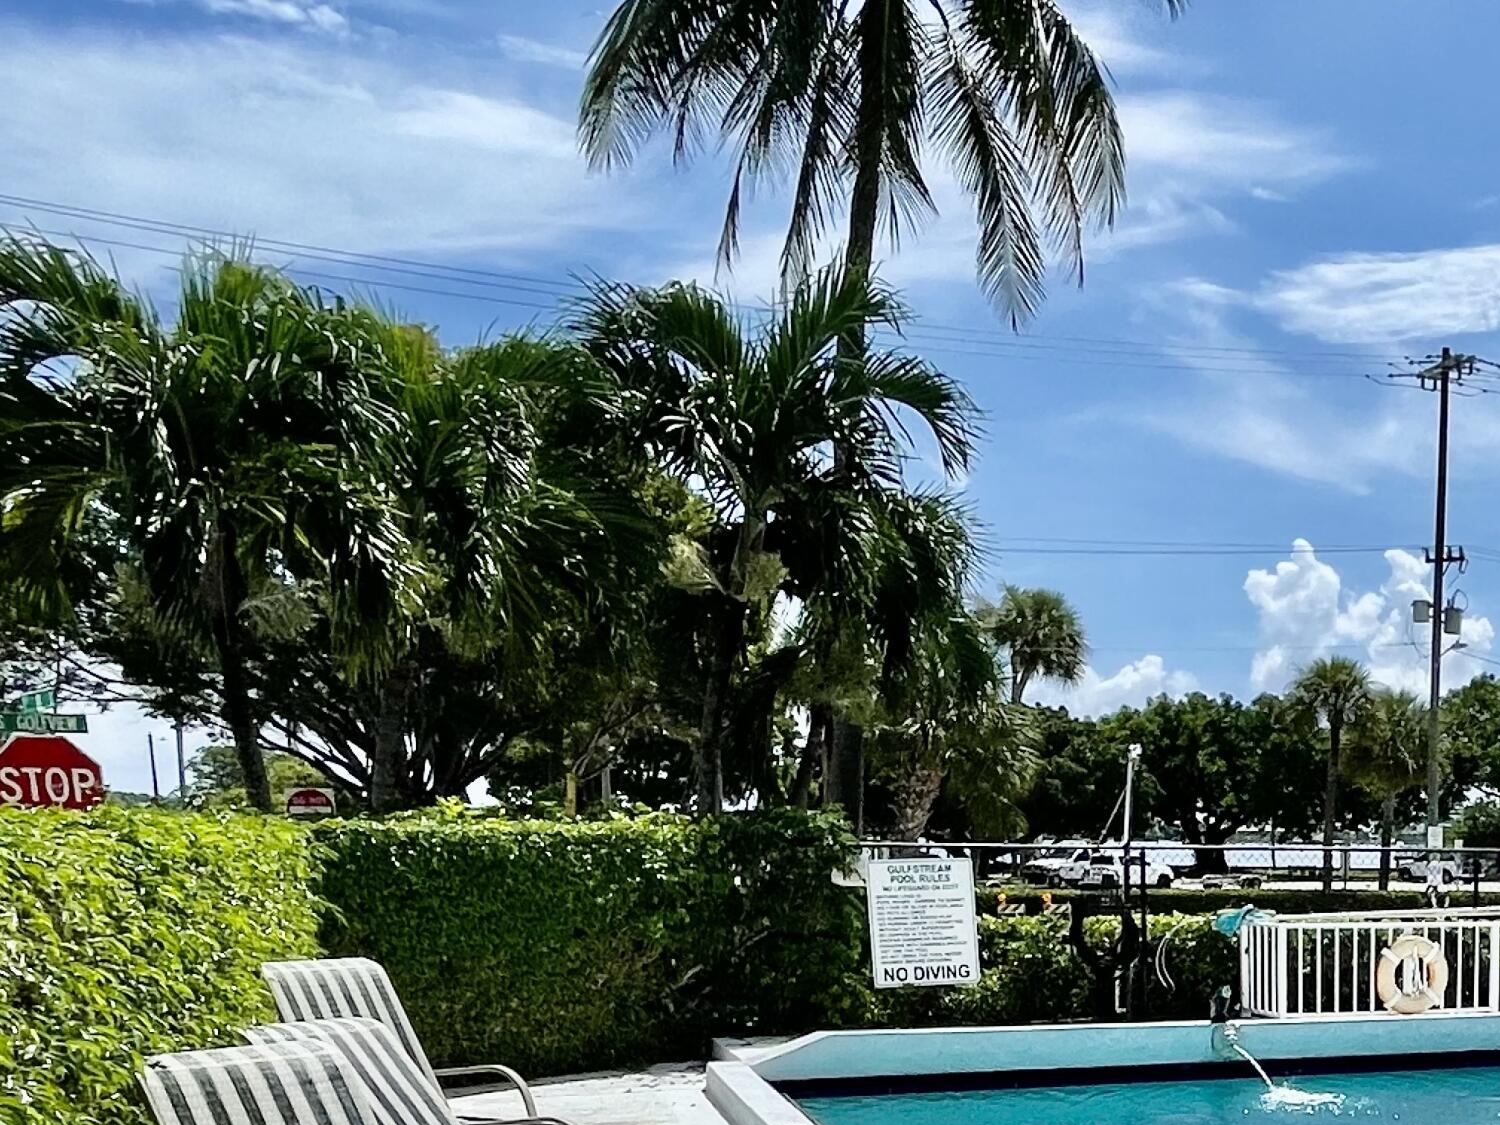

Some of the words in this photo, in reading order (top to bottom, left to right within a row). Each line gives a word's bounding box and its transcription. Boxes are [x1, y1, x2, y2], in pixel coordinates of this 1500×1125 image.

[0, 766, 95, 803] STOP
[887, 864, 951, 874] GULFSTREAM
[890, 875, 916, 883] POOL
[919, 874, 950, 882] RULES
[884, 967, 908, 982] NO
[914, 964, 970, 981] DIVING
